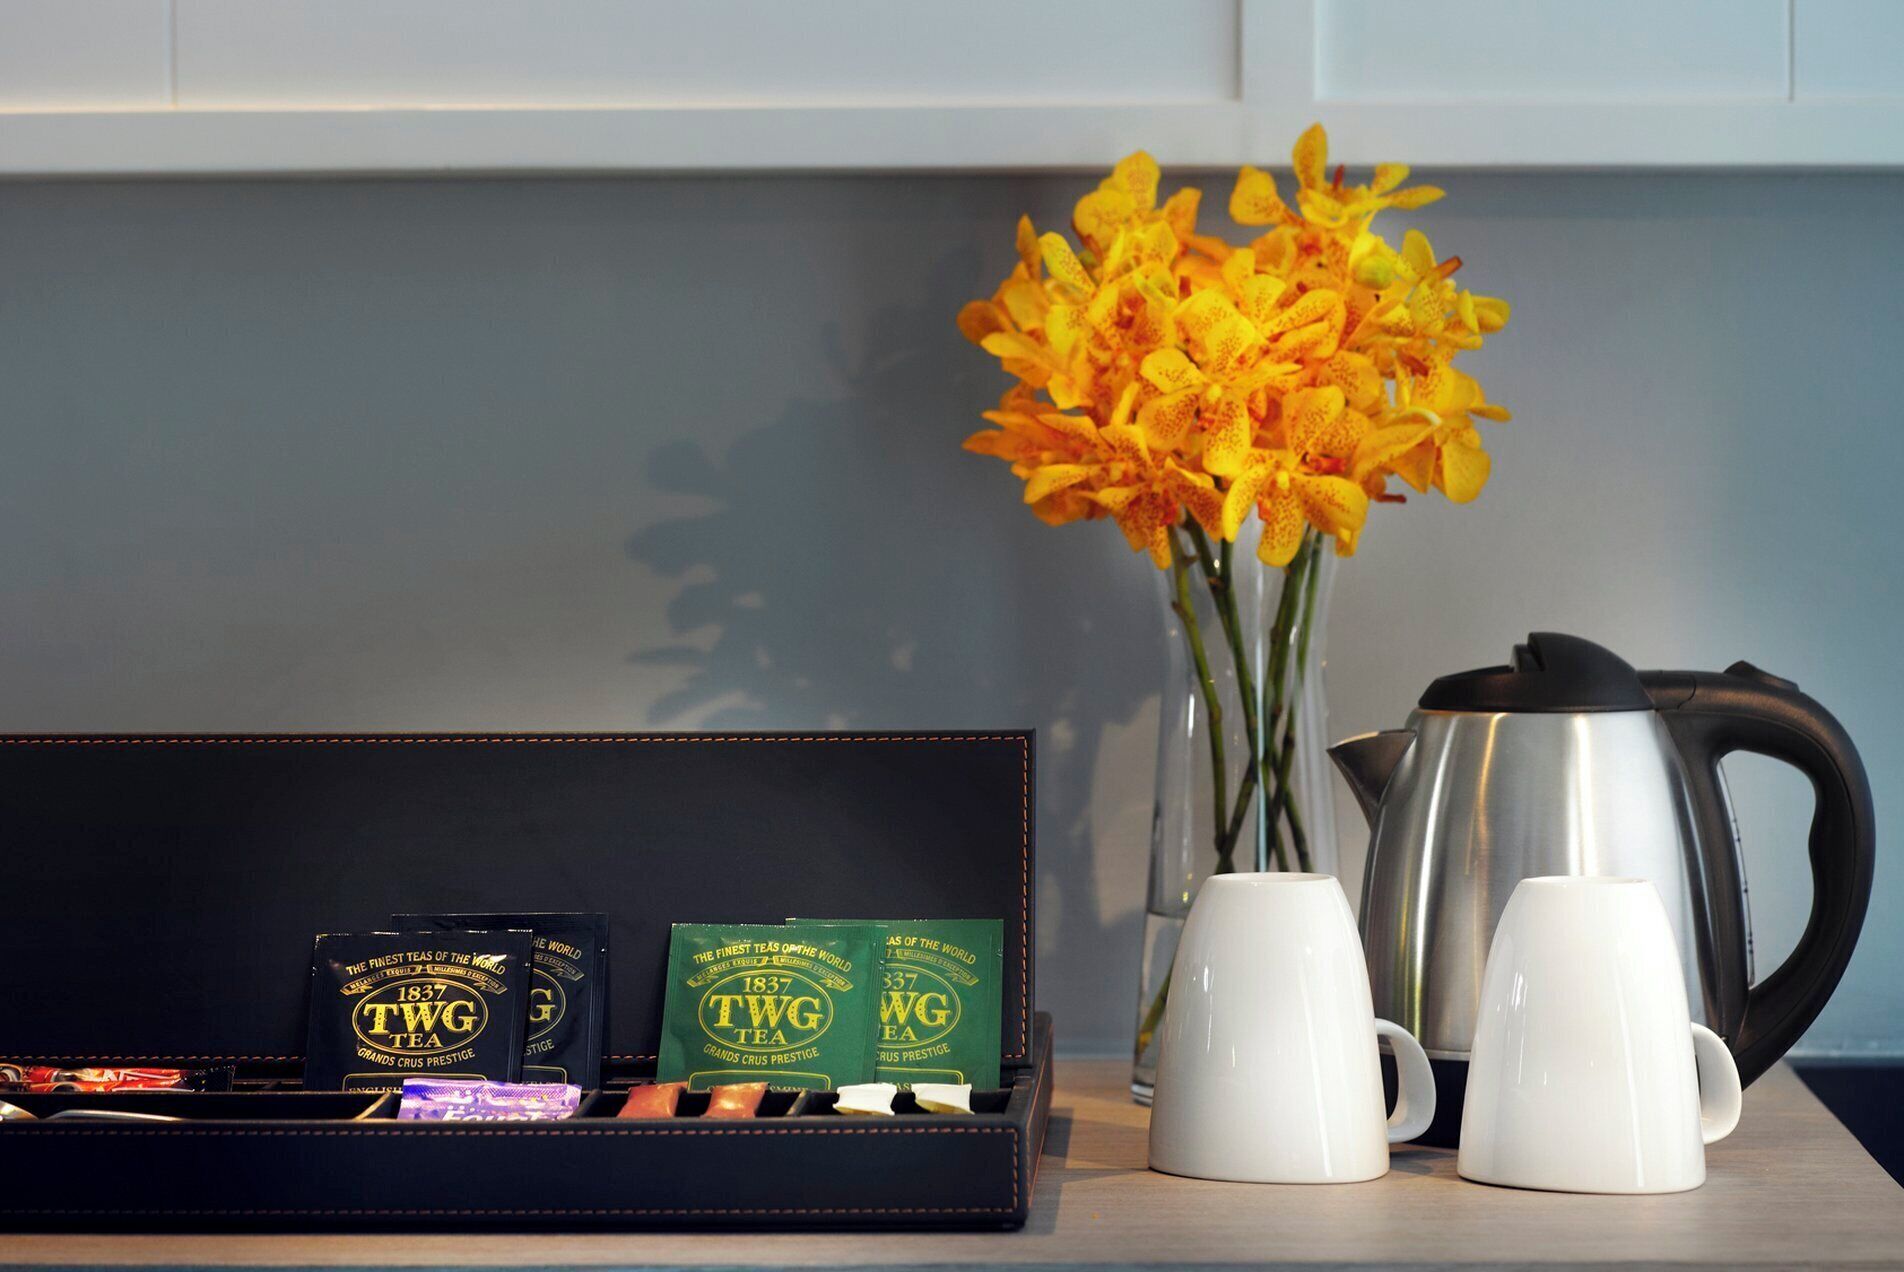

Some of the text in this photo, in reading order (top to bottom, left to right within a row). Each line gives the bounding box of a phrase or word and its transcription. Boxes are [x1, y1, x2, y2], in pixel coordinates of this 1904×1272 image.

[532, 937, 547, 949] HE
[548, 940, 582, 960] WORLD
[692, 952, 715, 965] THE
[716, 943, 751, 959] FINEST
[753, 942, 779, 953] TEAS
[796, 944, 818, 958] THE
[818, 949, 852, 973] WORLD
[904, 937, 918, 947] OF
[919, 938, 940, 951] THE
[942, 943, 977, 965] WORLD
[345, 950, 506, 976] THE FINEST TEAS OF THE WORLD
[397, 984, 448, 1002] 1837
[742, 976, 793, 994] 1837
[363, 1000, 479, 1035] TWG
[708, 994, 824, 1031] TWG
[880, 991, 951, 1027] WG
[388, 1032, 444, 1048] TEA
[733, 1028, 788, 1045] TEA
[881, 1025, 919, 1041] EA
[357, 1047, 476, 1068] GRANDS CRUS PRESTIGE
[703, 1043, 820, 1065] GRANDS CRUS PRESTIGE
[902, 1043, 951, 1062] PRESTIGE
